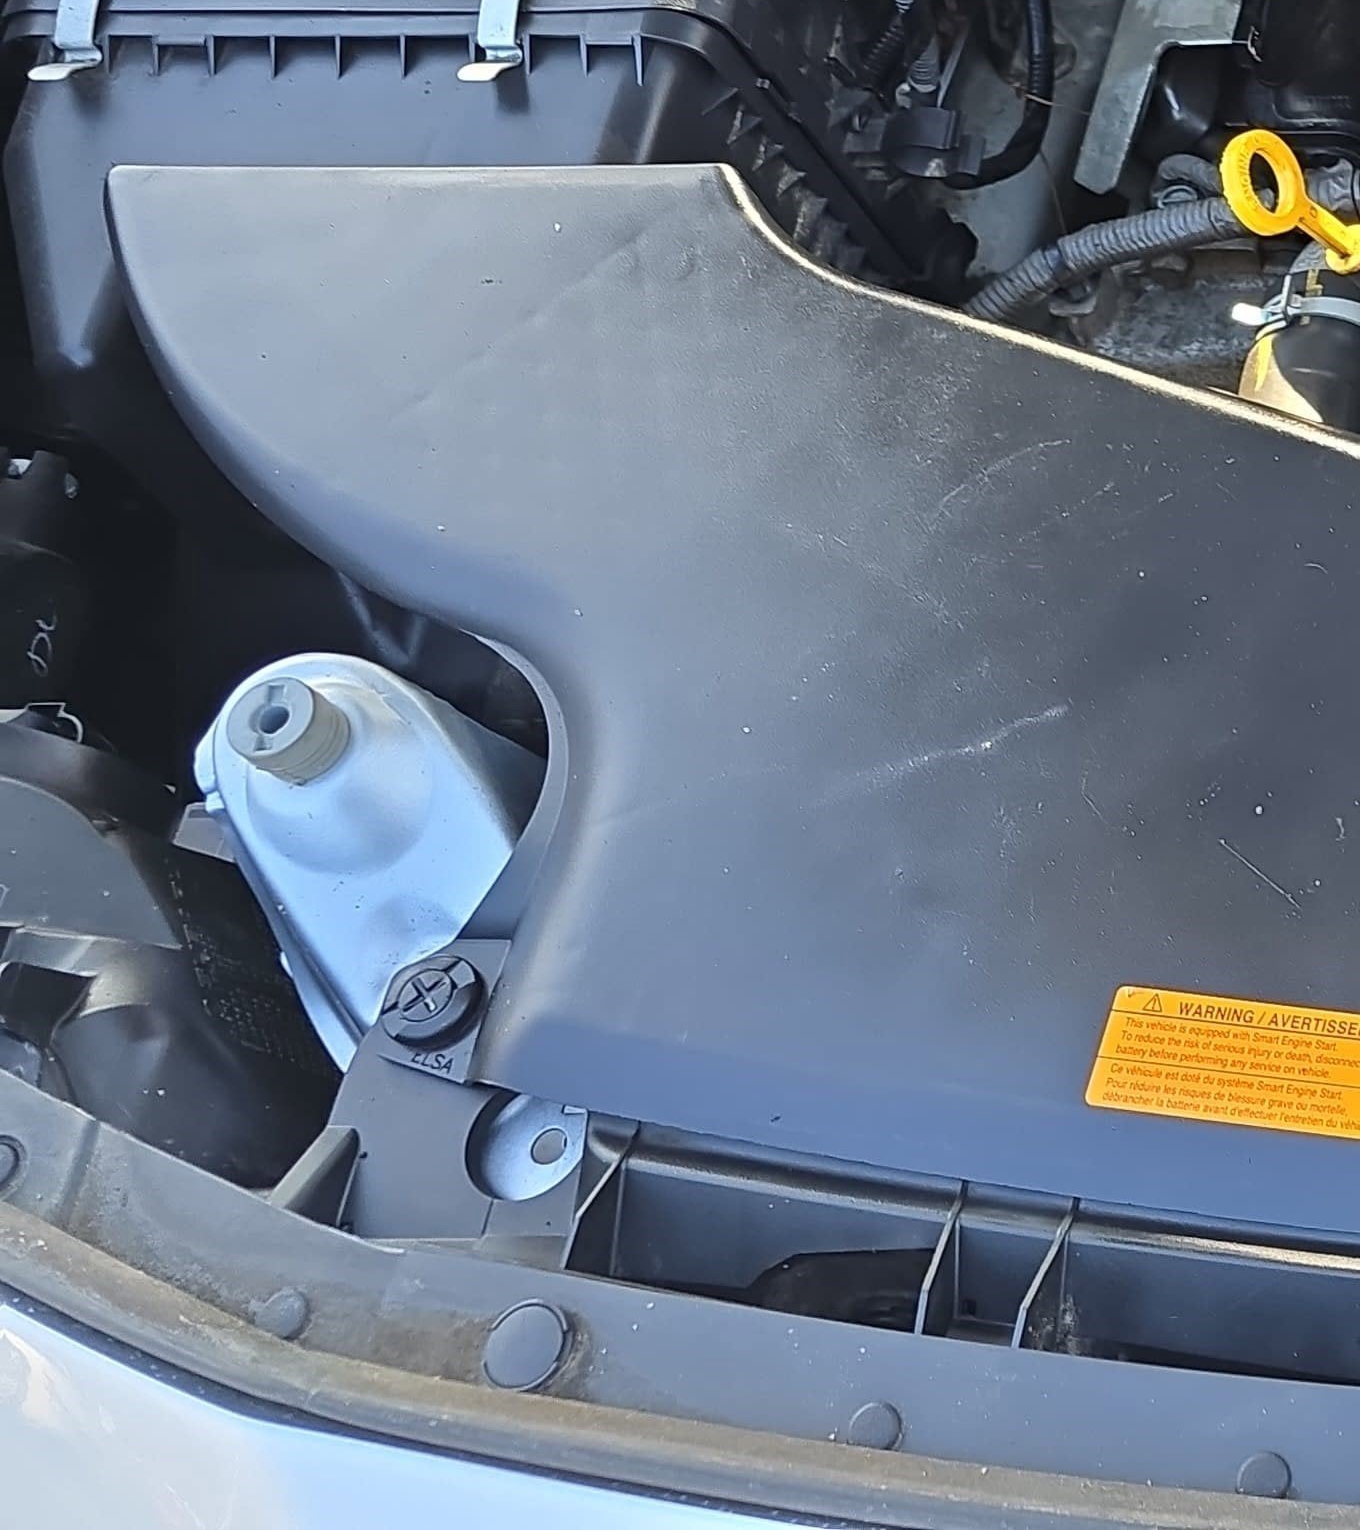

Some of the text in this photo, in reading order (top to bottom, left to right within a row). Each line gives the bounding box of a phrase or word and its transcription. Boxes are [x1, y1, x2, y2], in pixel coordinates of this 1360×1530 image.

[1179, 1001, 1255, 1024] WARNING
[1257, 1011, 1266, 1024] /
[1121, 1030, 1132, 1040] To
[1134, 1034, 1166, 1045] reduce
[1168, 1036, 1182, 1047] the
[1184, 1037, 1199, 1048] risk
[1202, 1040, 1212, 1050] of
[1213, 1042, 1245, 1055] serious
[1247, 1046, 1272, 1059] injury
[1274, 1050, 1284, 1059] or
[1125, 1017, 1144, 1029] This
[1146, 1021, 1177, 1032] vehicle
[1179, 1024, 1187, 1033] is
[1189, 1025, 1230, 1039] equipped
[1232, 1031, 1250, 1042] with
[1252, 1032, 1279, 1045] Smart
[1281, 1035, 1313, 1049] Engine
[1115, 1045, 1331, 1079] battery before performing any service on vehicle.
[1105, 1077, 1127, 1088] Pour
[1164, 1084, 1176, 1095] les
[1179, 1086, 1212, 1101] risques
[1213, 1089, 1226, 1101] de
[1228, 1091, 1266, 1106] blessure
[1268, 1099, 1293, 1111] grave
[1296, 1102, 1308, 1111] ou
[1110, 1063, 1124, 1074] Ce
[1165, 1070, 1179, 1080] est
[1203, 1073, 1215, 1085] du
[1256, 1080, 1284, 1093] Smart
[1286, 1084, 1317, 1098] Engine
[1156, 1098, 1164, 1108] la
[1166, 1099, 1200, 1112] batterie
[1203, 1104, 1228, 1115] avant
[1326, 1116, 1337, 1128] du
